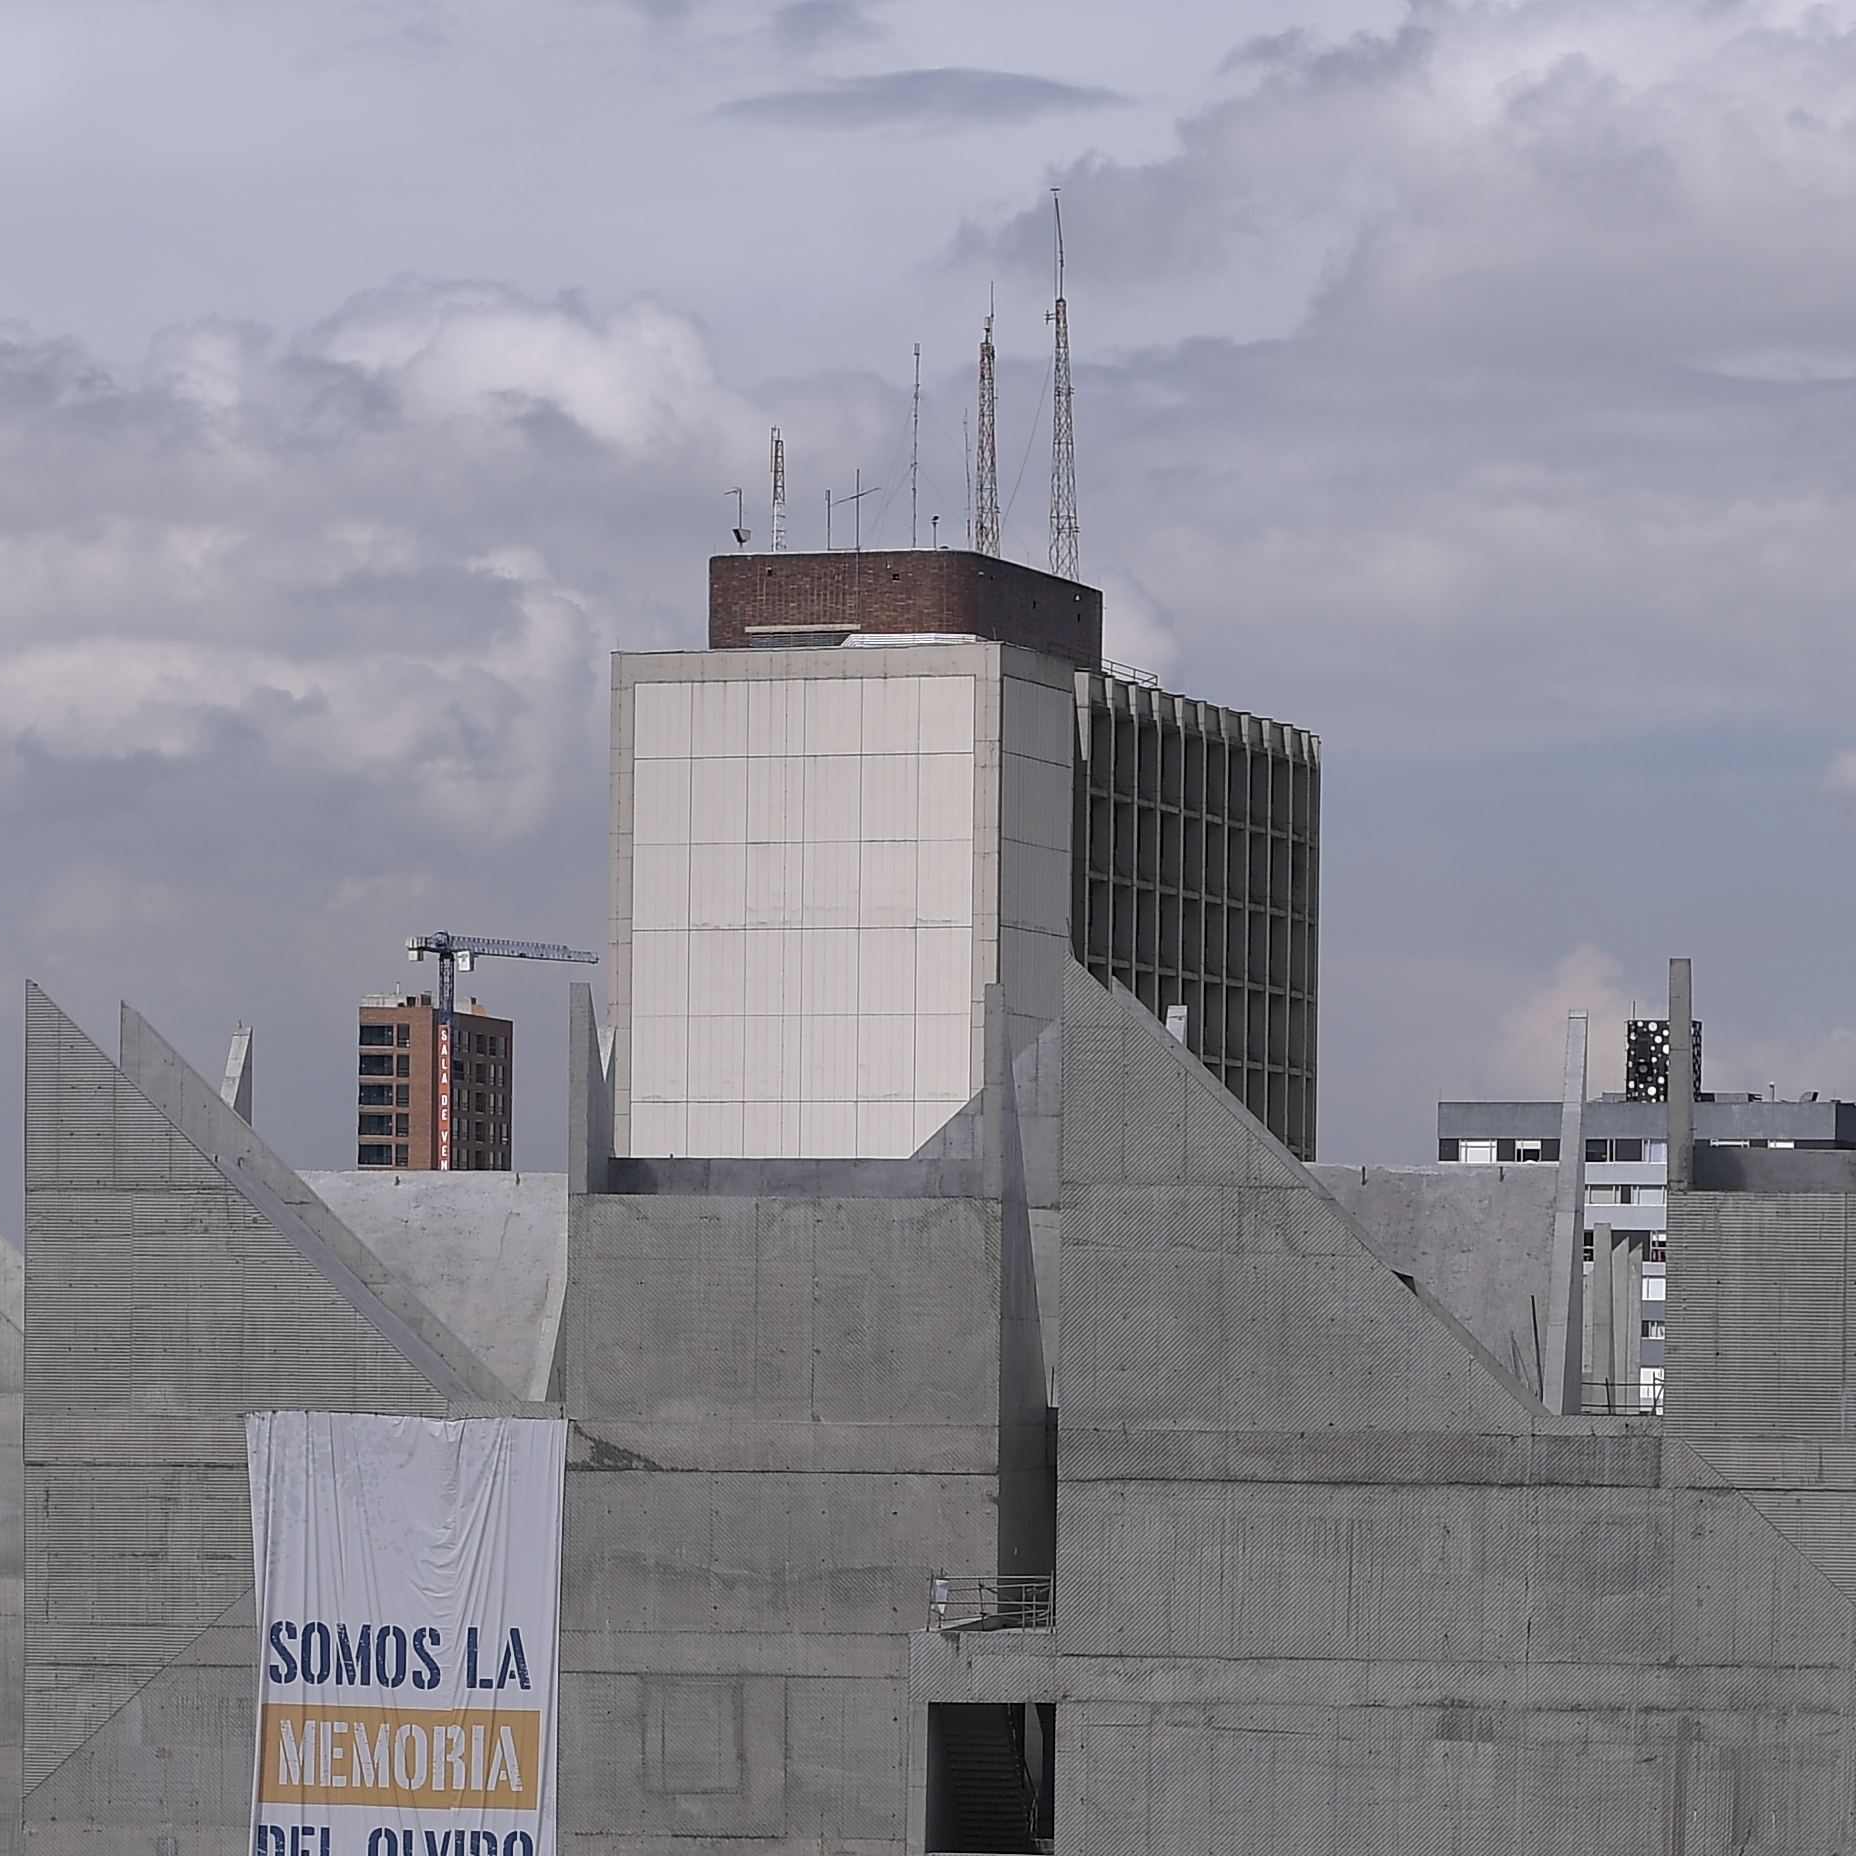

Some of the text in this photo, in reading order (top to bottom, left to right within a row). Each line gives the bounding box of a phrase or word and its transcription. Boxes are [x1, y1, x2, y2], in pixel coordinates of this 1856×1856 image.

[268, 1620, 531, 1690] SOMOS LA
[278, 1719, 524, 1792] MEMORIA
